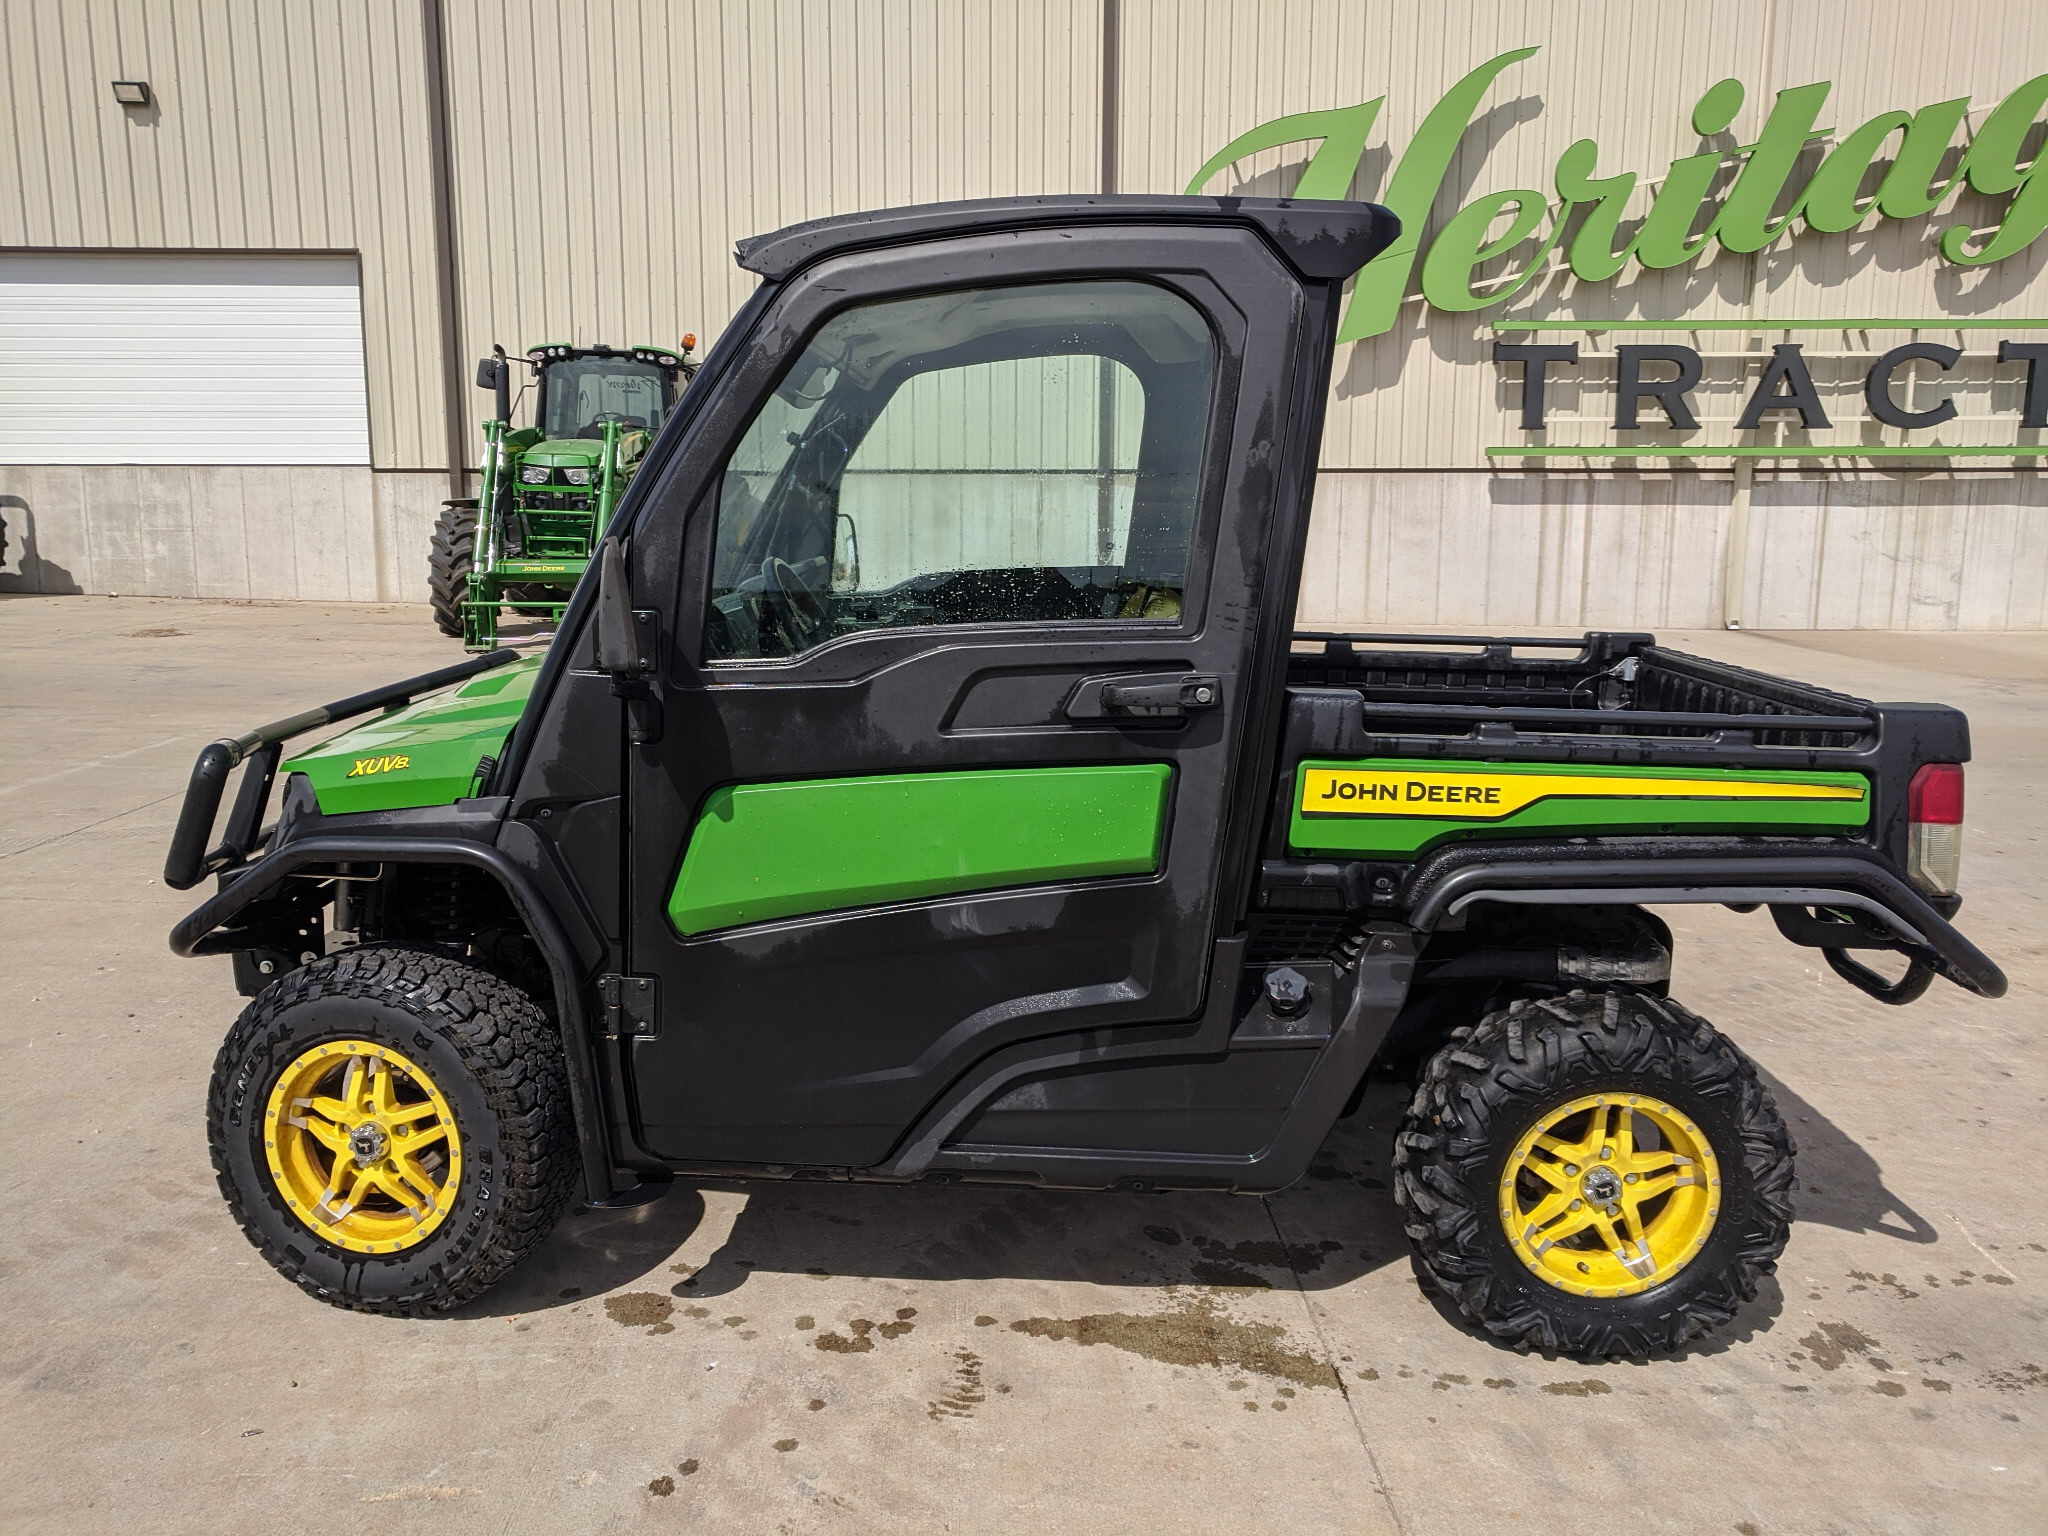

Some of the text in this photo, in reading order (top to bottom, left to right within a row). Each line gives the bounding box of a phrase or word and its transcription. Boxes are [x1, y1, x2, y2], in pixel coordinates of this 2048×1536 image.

[1493, 339, 2048, 430] TRACT
[1321, 779, 1501, 804] JOHN DEERE
